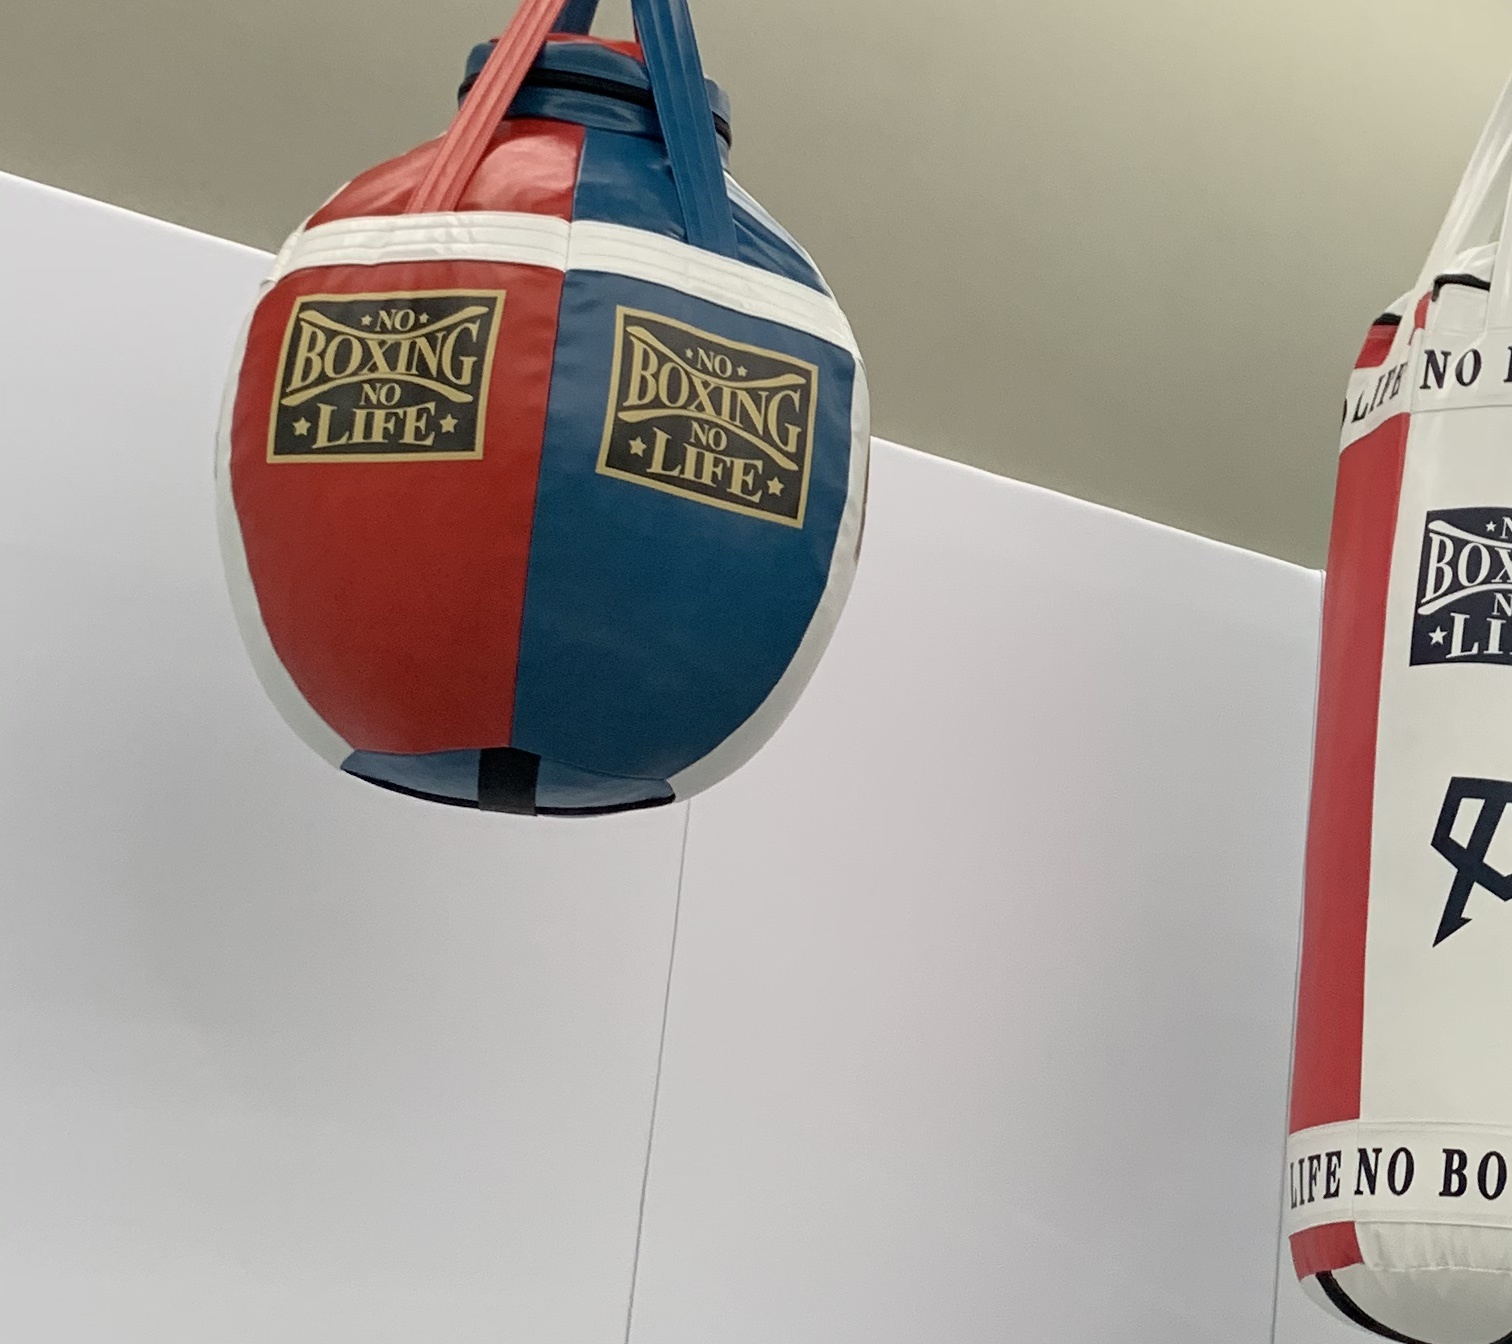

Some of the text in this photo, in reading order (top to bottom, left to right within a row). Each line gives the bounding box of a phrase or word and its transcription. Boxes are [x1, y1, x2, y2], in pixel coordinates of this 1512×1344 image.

[375, 309, 416, 332] NO
[286, 319, 480, 393] BOXING
[696, 347, 733, 378] NO
[1419, 347, 1482, 391] NO
[358, 382, 402, 406] NO
[623, 335, 802, 453] BOXING
[312, 401, 436, 449] LIFE
[689, 420, 728, 452] NO
[646, 427, 764, 504] LIFE
[1290, 1150, 1342, 1210] LIFE
[1354, 1146, 1415, 1197] NO
